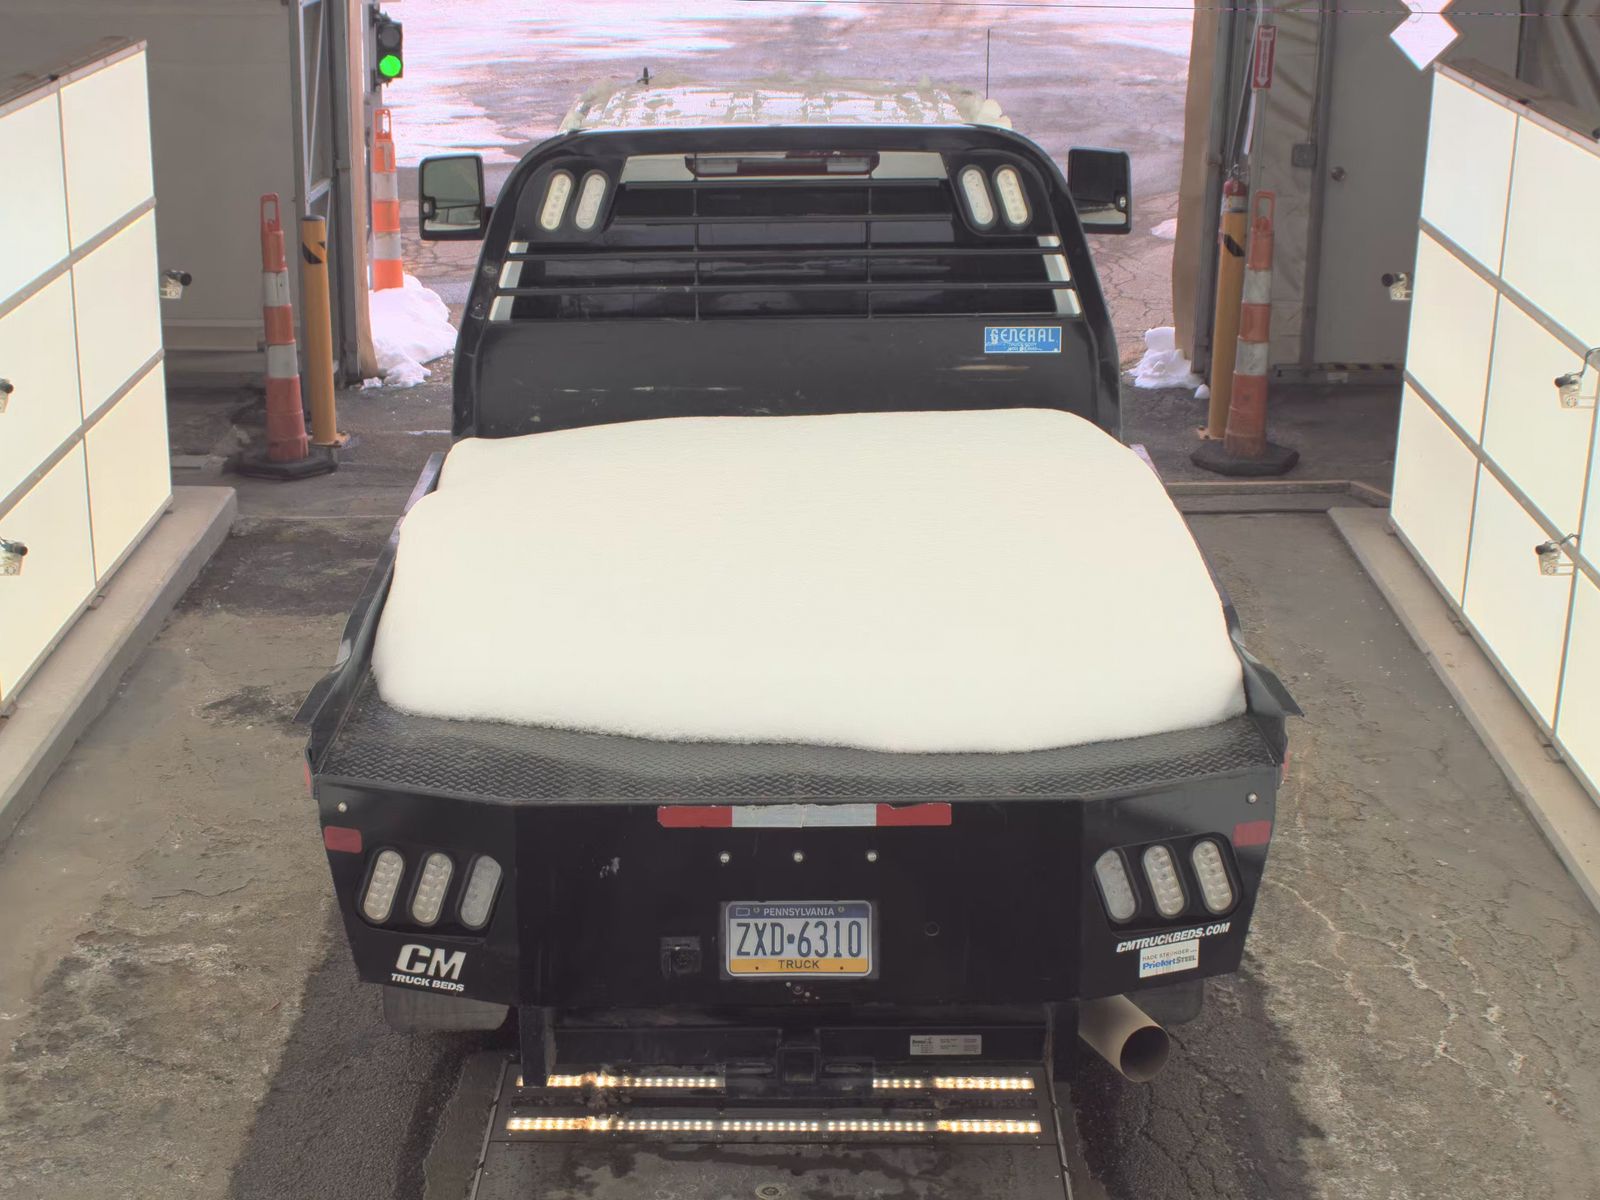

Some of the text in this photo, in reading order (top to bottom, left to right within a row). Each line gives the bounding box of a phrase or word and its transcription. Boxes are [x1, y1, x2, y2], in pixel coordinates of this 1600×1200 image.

[990, 328, 1055, 344] GENERAL
[763, 907, 834, 917] PENNSYLVANIA
[1116, 922, 1231, 953] CMTRUCKBEDS.COM
[395, 944, 467, 980] CM
[778, 959, 820, 969] TRUCK
[391, 973, 465, 992] TRUCK BEDS
